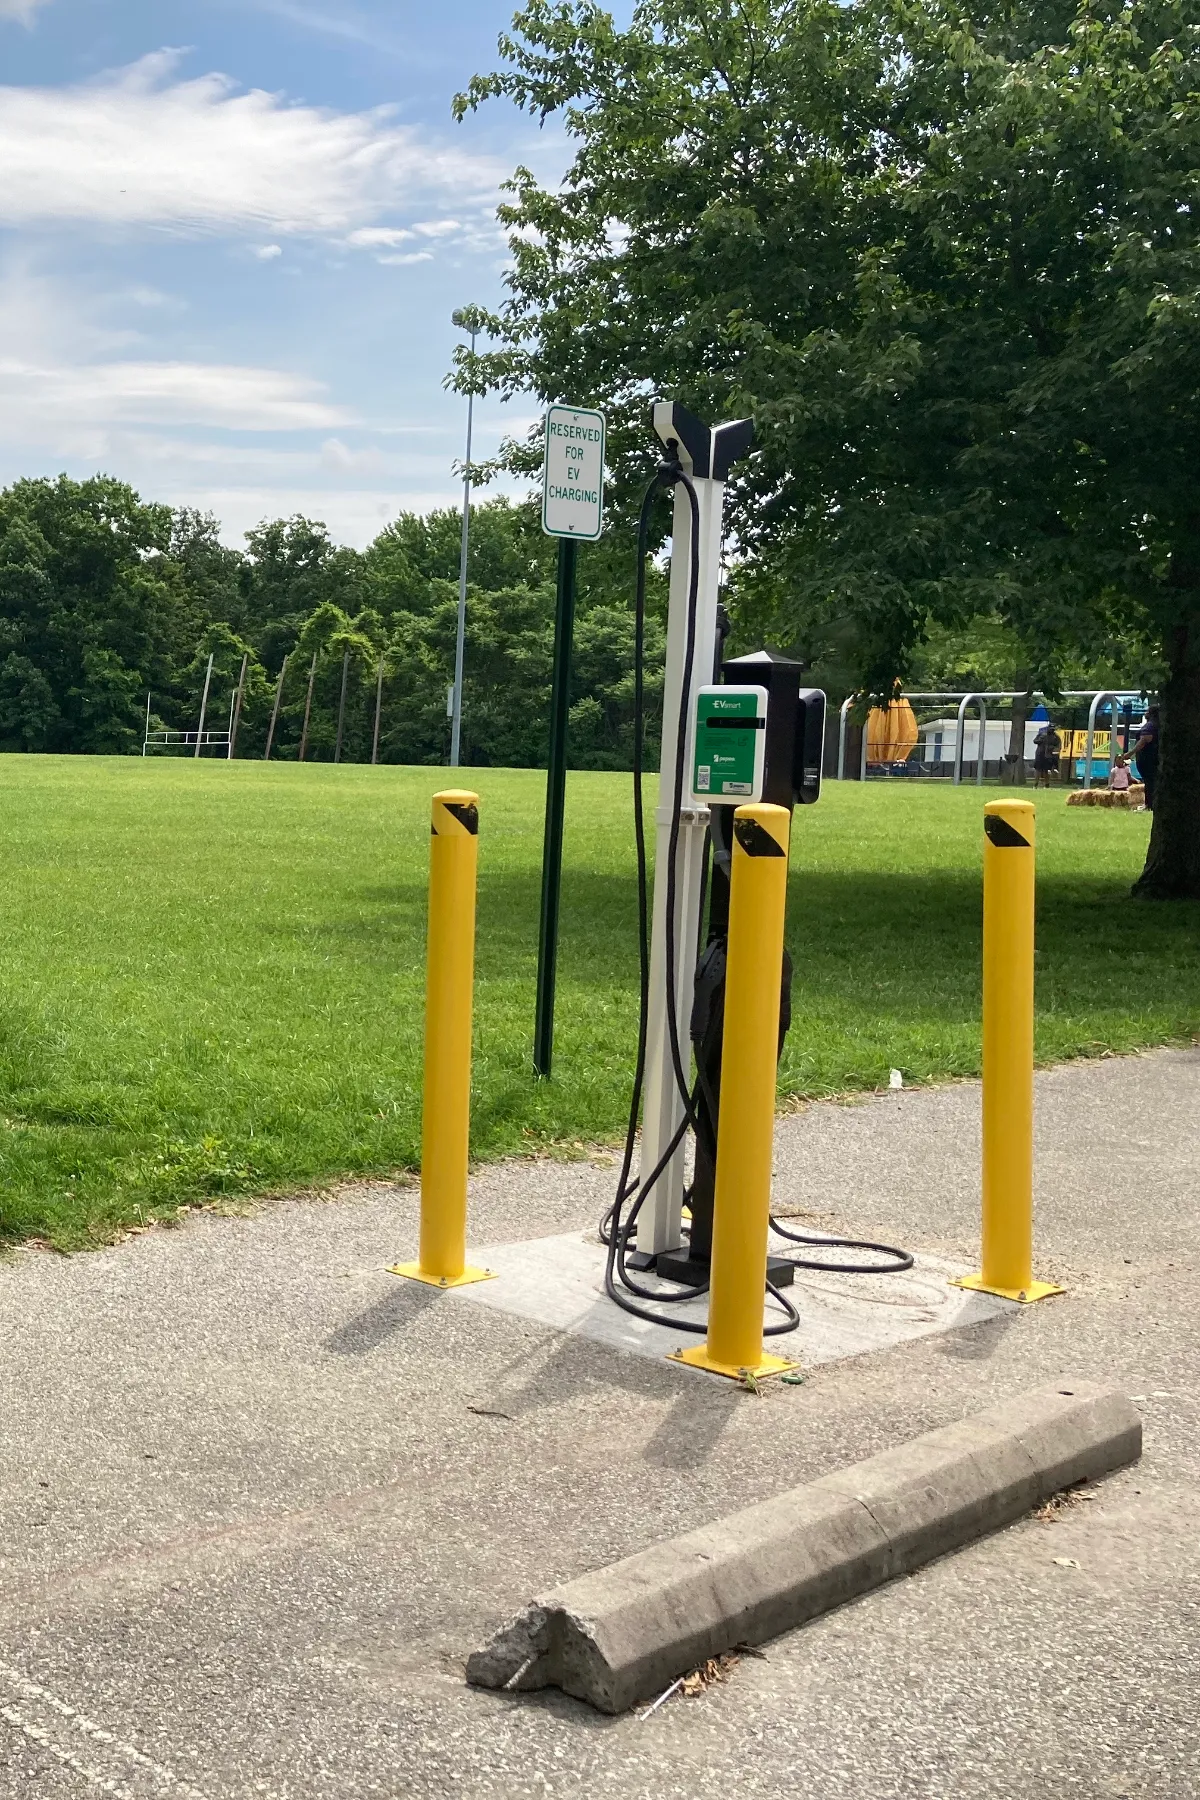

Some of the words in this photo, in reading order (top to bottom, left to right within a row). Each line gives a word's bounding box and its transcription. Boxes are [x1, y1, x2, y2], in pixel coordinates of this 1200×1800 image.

[550, 422, 600, 442] RESERVED
[565, 446, 583, 460] FOR
[568, 467, 580, 480] EV
[549, 485, 597, 503] CHARGING
